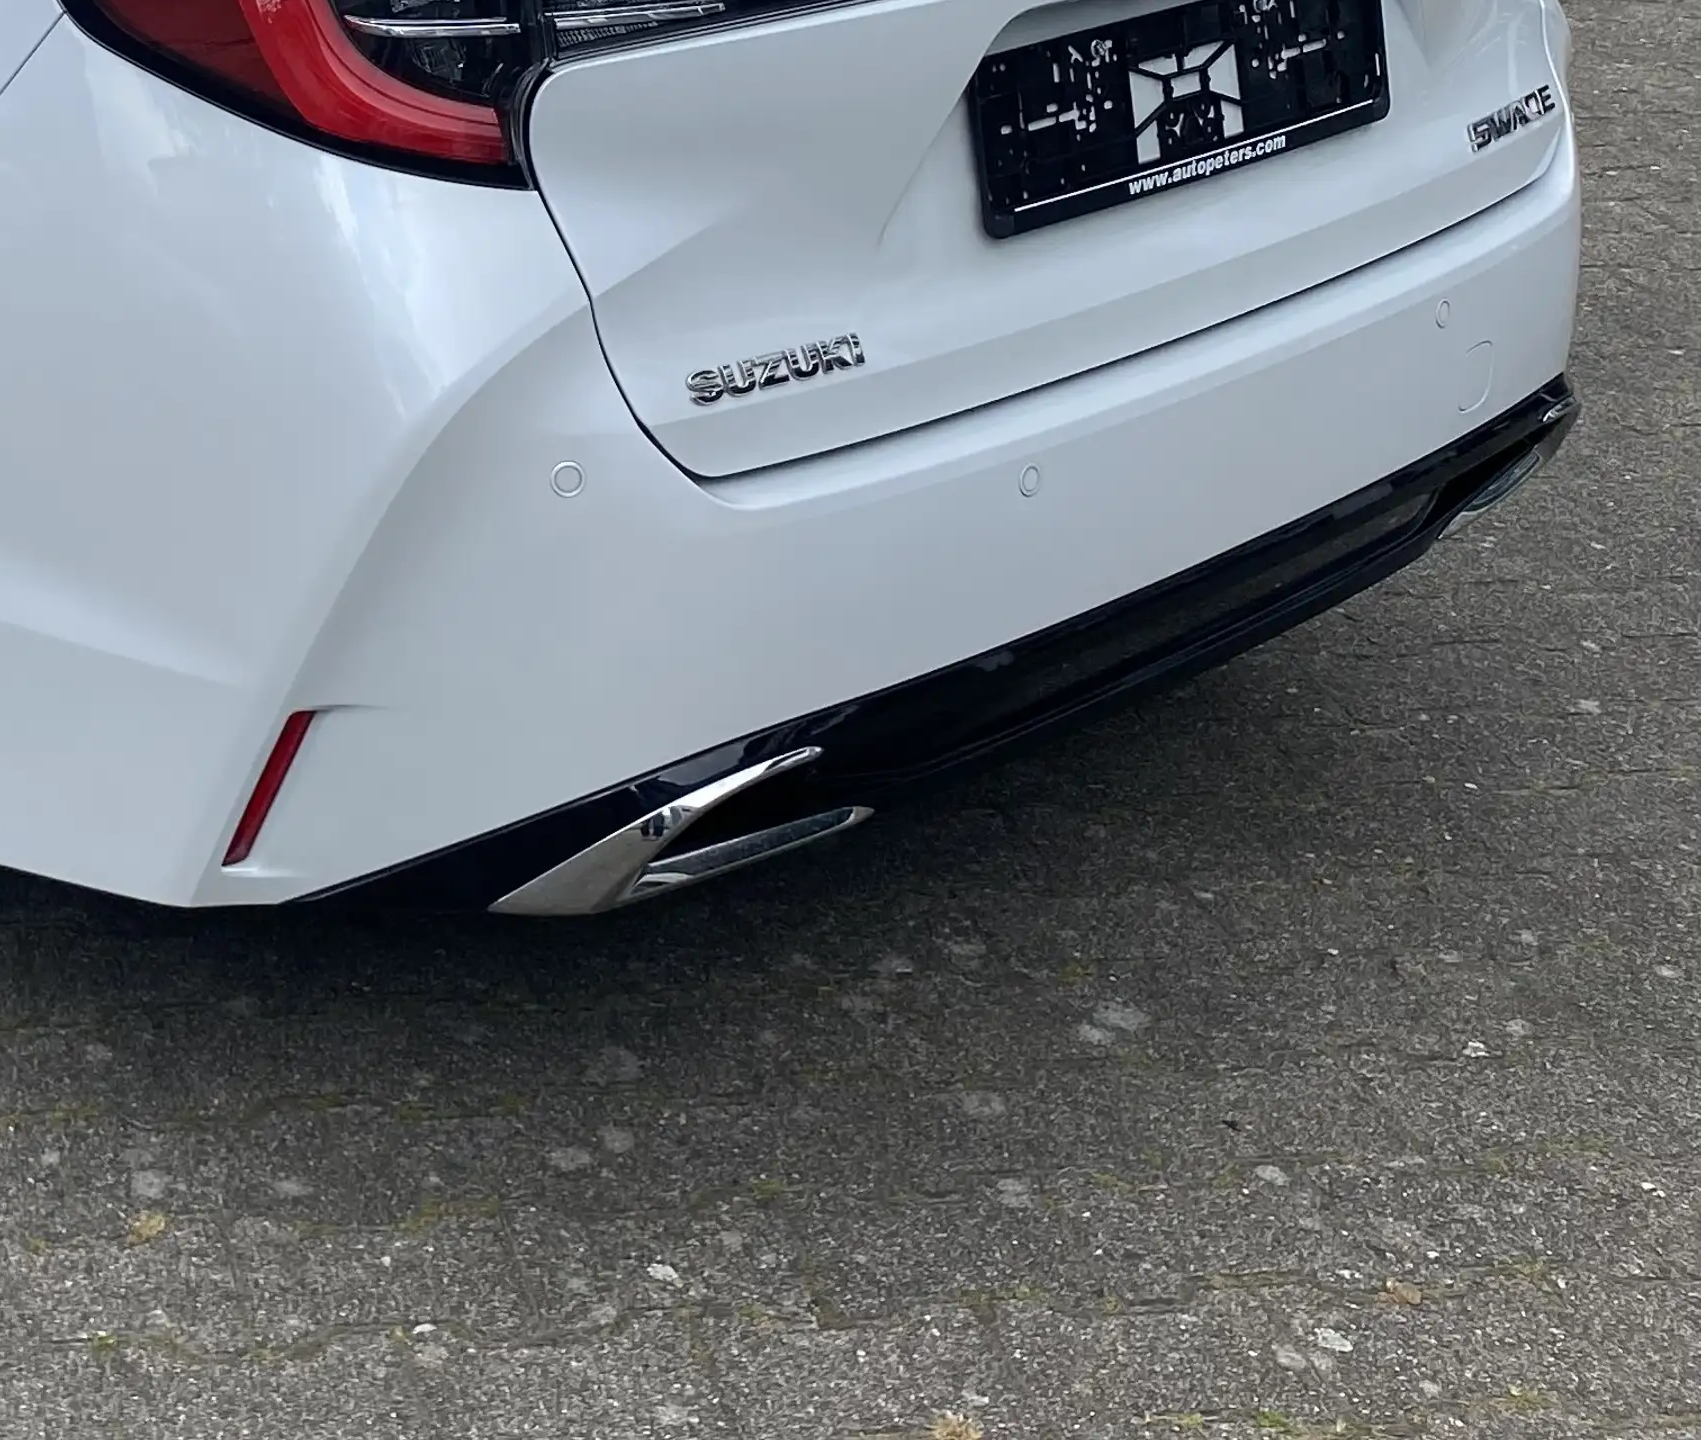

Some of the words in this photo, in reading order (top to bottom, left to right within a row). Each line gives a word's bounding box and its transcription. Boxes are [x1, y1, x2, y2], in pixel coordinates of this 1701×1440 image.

[1467, 84, 1556, 152] SWACE
[1128, 133, 1287, 196] www.autopeters.com
[685, 332, 866, 406] SUZUKI
